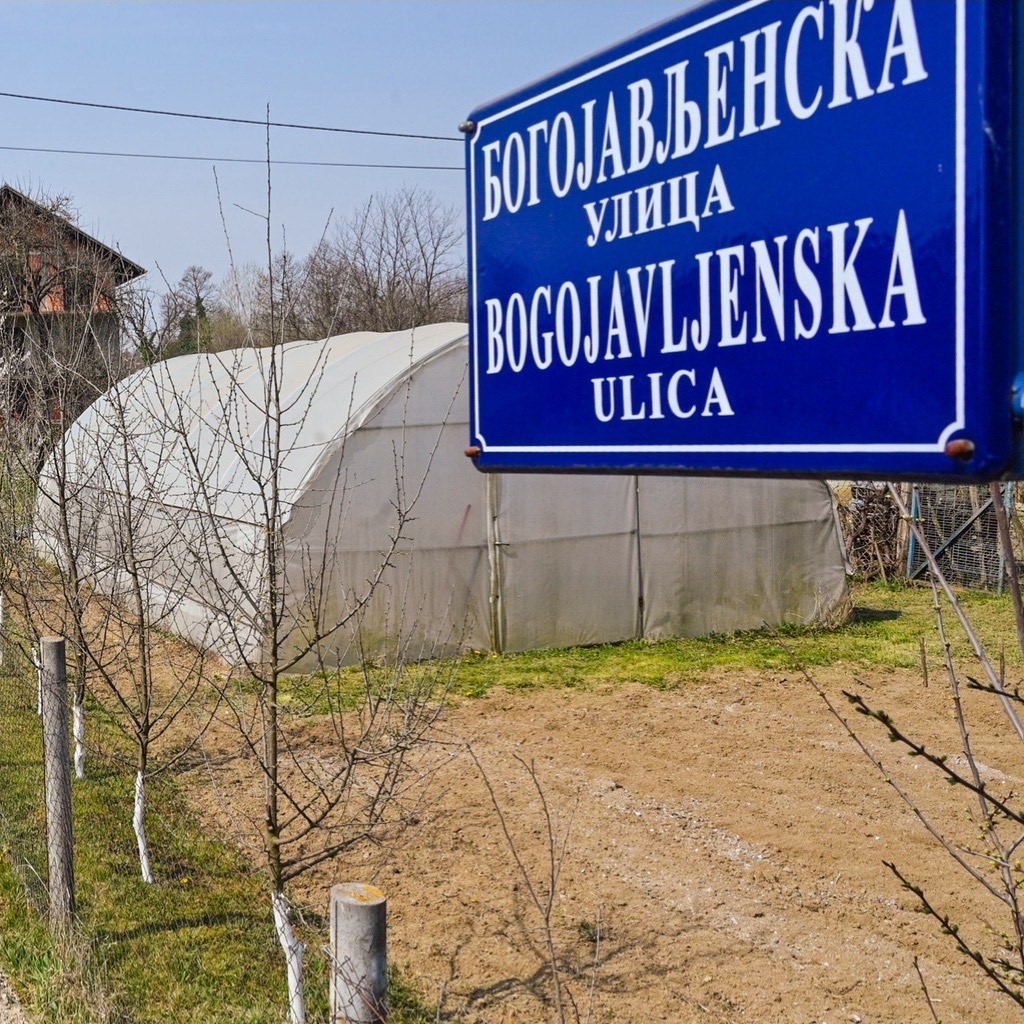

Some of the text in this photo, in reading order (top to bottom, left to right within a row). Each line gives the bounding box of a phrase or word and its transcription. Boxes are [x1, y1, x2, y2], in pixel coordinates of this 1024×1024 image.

[482, 0, 929, 222] БОГОЈАВЉЕНСКА
[583, 164, 735, 247] УЛИЦА
[485, 208, 927, 375] BOGOJAVLJENSKA
[591, 367, 735, 422] ULICA
